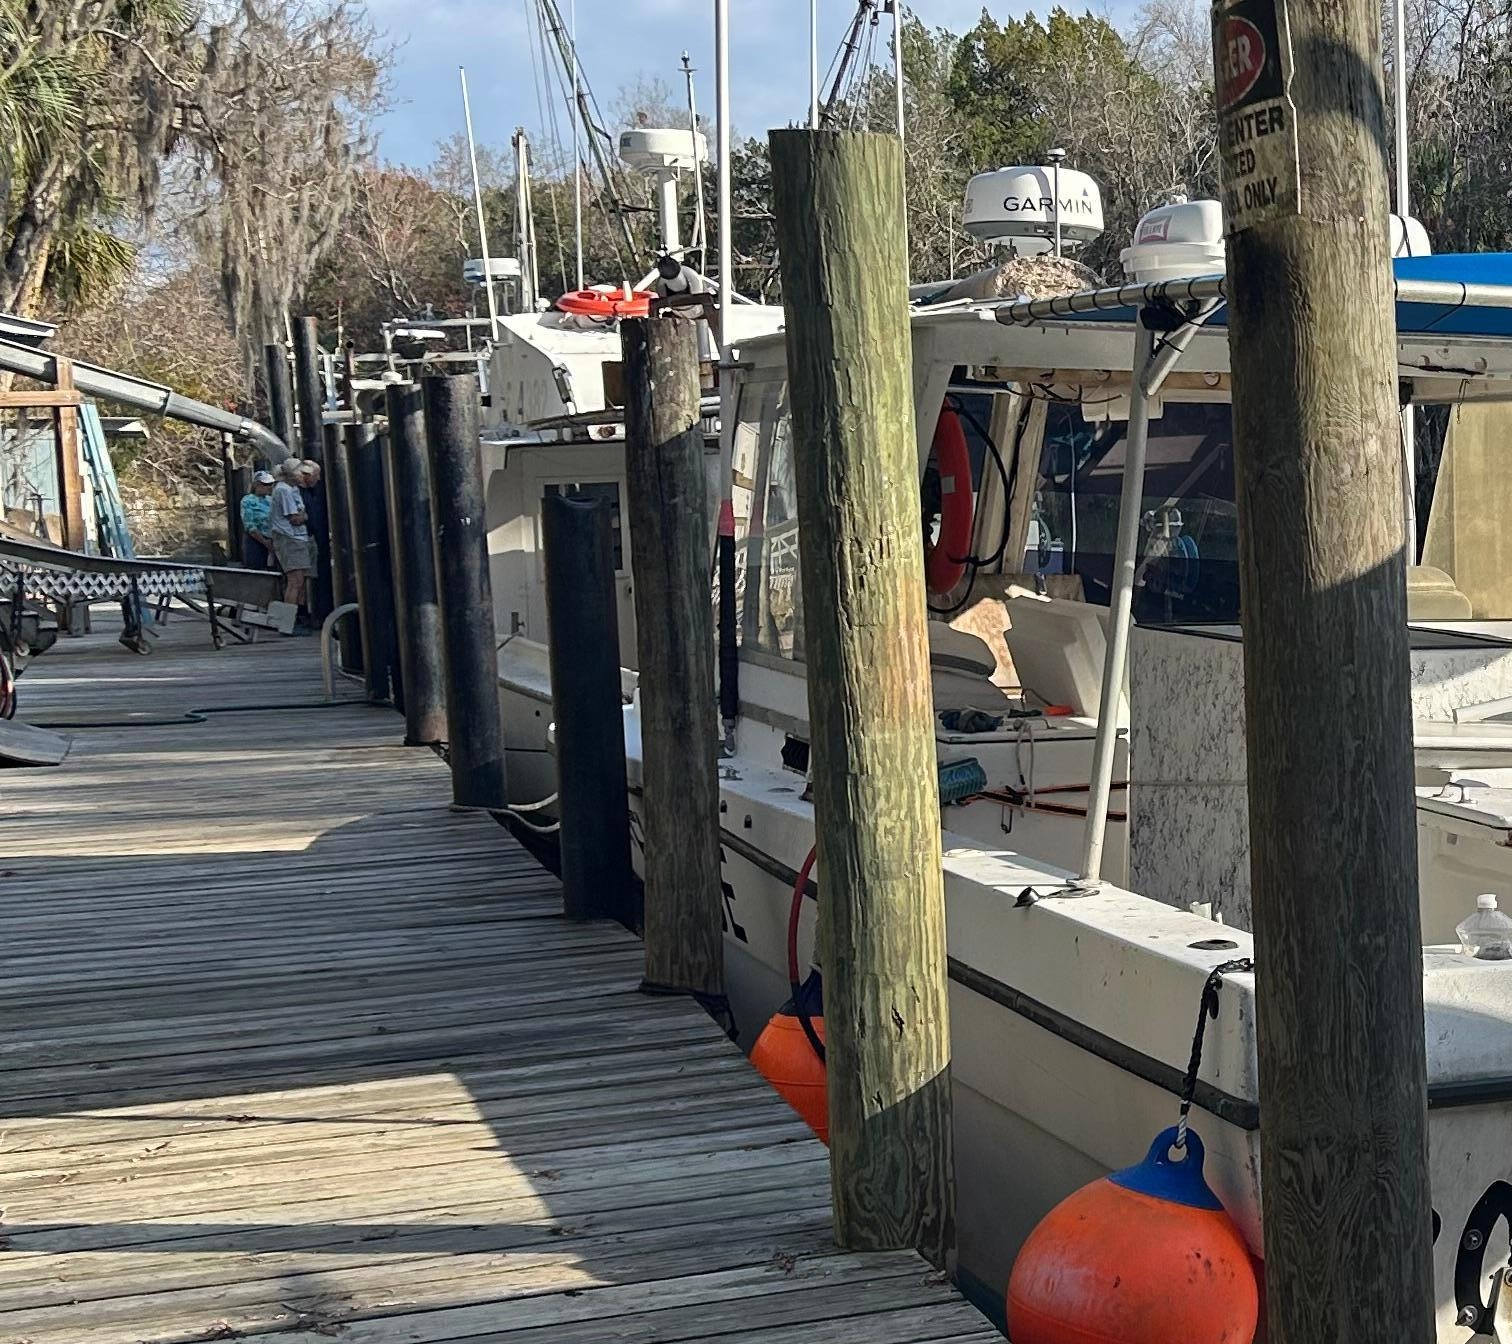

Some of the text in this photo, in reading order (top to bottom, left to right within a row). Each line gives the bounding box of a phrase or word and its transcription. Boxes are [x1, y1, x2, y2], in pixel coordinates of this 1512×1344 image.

[1224, 34, 1254, 80] ER
[1227, 106, 1285, 146] ENTER
[1003, 196, 1093, 214] GARMIN
[1244, 176, 1278, 209] ONLY
